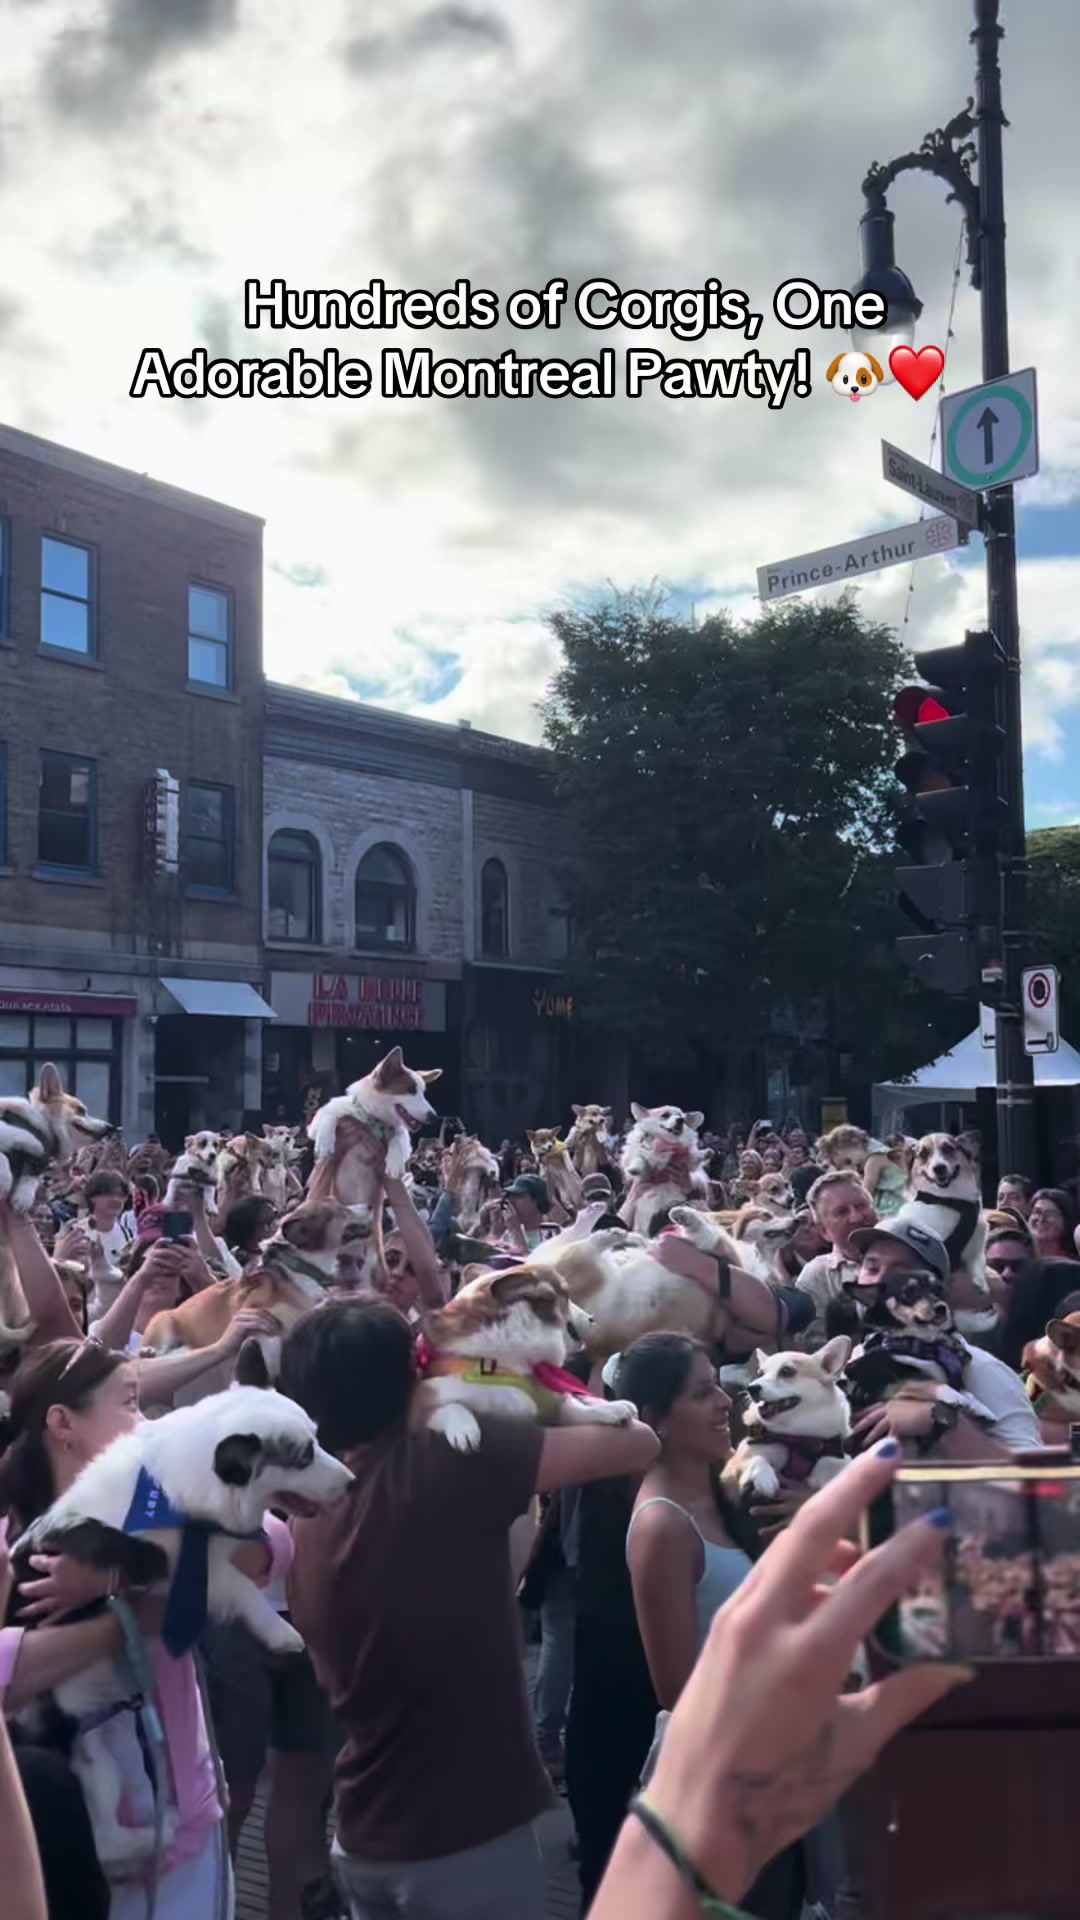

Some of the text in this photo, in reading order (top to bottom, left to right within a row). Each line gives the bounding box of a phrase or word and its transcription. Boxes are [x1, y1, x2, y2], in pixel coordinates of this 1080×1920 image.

[767, 540, 915, 593] Prince-Arthur
[313, 972, 348, 1000] LA
[144, 1481, 160, 1518] UBY
